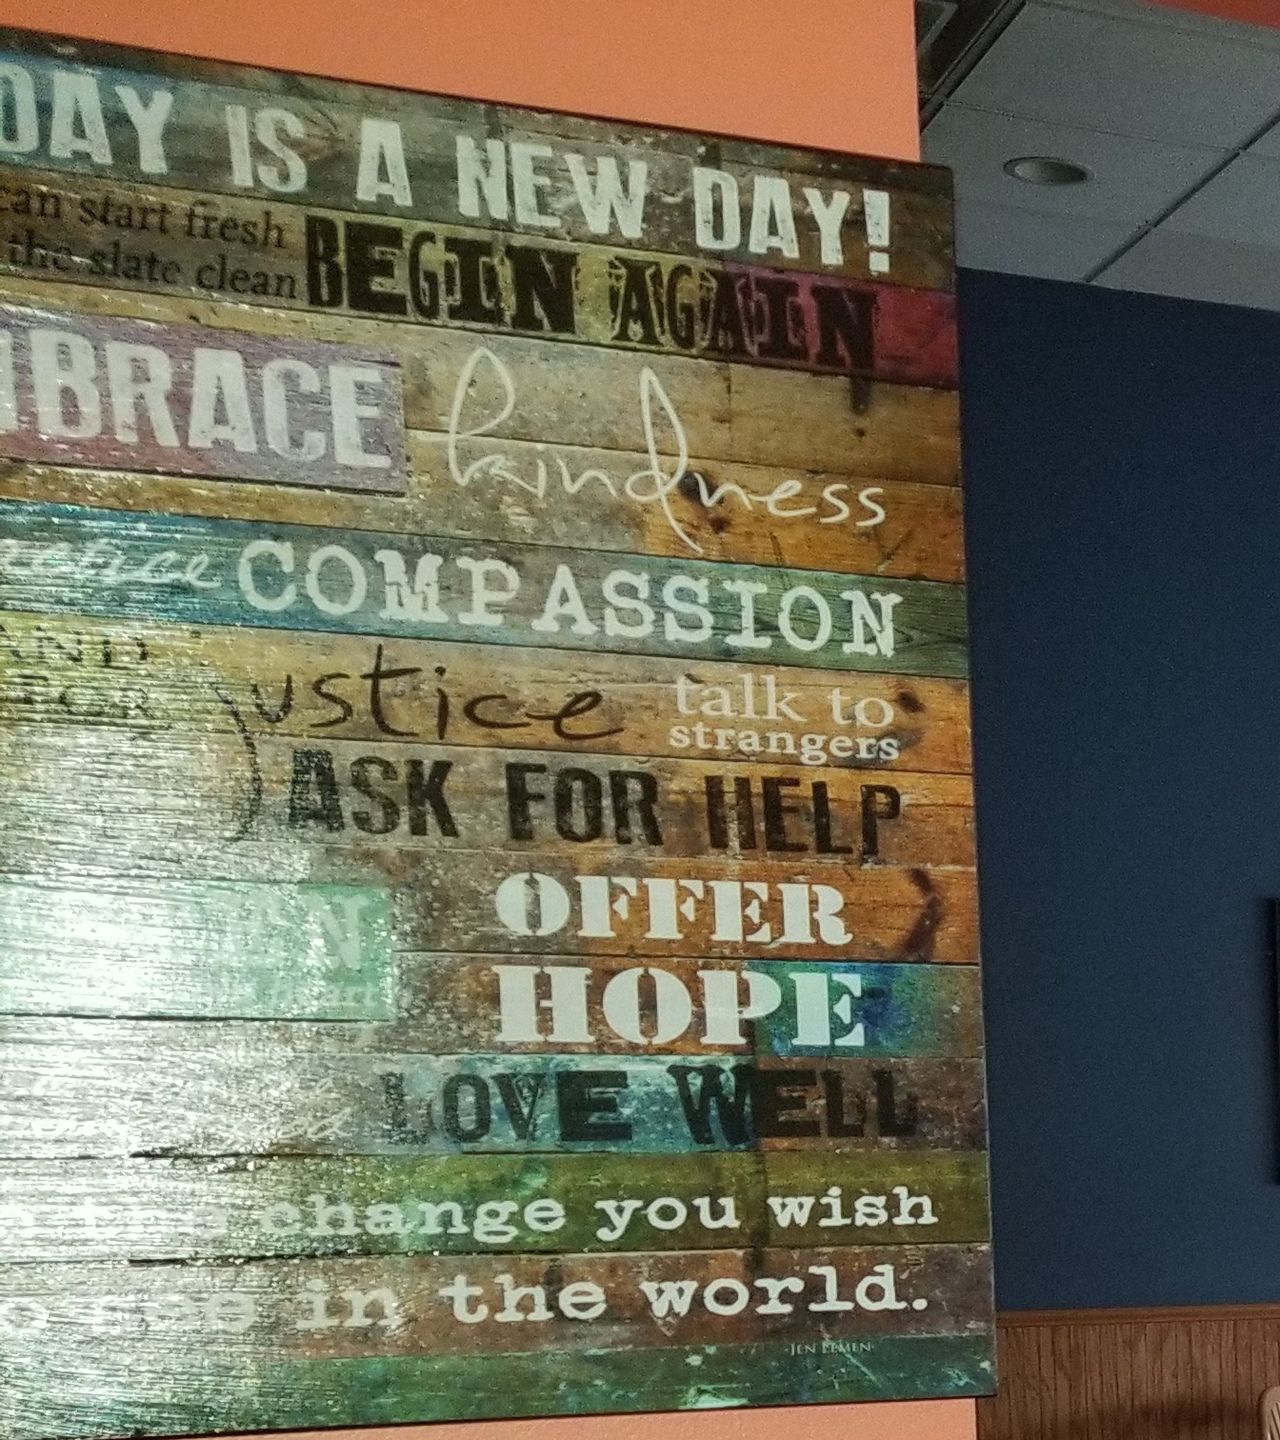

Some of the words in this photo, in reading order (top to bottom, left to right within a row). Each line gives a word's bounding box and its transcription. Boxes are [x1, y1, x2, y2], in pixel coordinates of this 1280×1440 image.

[79, 195, 171, 235] start
[185, 201, 287, 250] fresh
[224, 103, 308, 194] IS
[355, 118, 413, 207] A
[455, 134, 649, 239] NEW
[692, 166, 890, 276] DAY!
[88, 239, 181, 284] slate
[196, 253, 297, 299] clean
[304, 213, 578, 335] BEGIN
[606, 254, 878, 371] AGAIN
[406, 346, 887, 553] kindness
[238, 539, 904, 659] COMPASSION
[675, 672, 808, 722] talk
[827, 687, 895, 728] to
[668, 721, 900, 766] strangers
[287, 748, 460, 840] ASK
[505, 762, 664, 847] FOR
[705, 775, 901, 867] HELP
[495, 871, 854, 946] OFFER
[491, 964, 867, 1049] HOPE
[379, 1070, 634, 1146] LOVE
[666, 1063, 918, 1147] WELL
[260, 1193, 567, 1245] change
[594, 1194, 742, 1242] you
[767, 1186, 939, 1229] wish
[297, 1277, 402, 1334] in
[438, 1273, 607, 1323] the
[639, 1263, 929, 1316] world.
